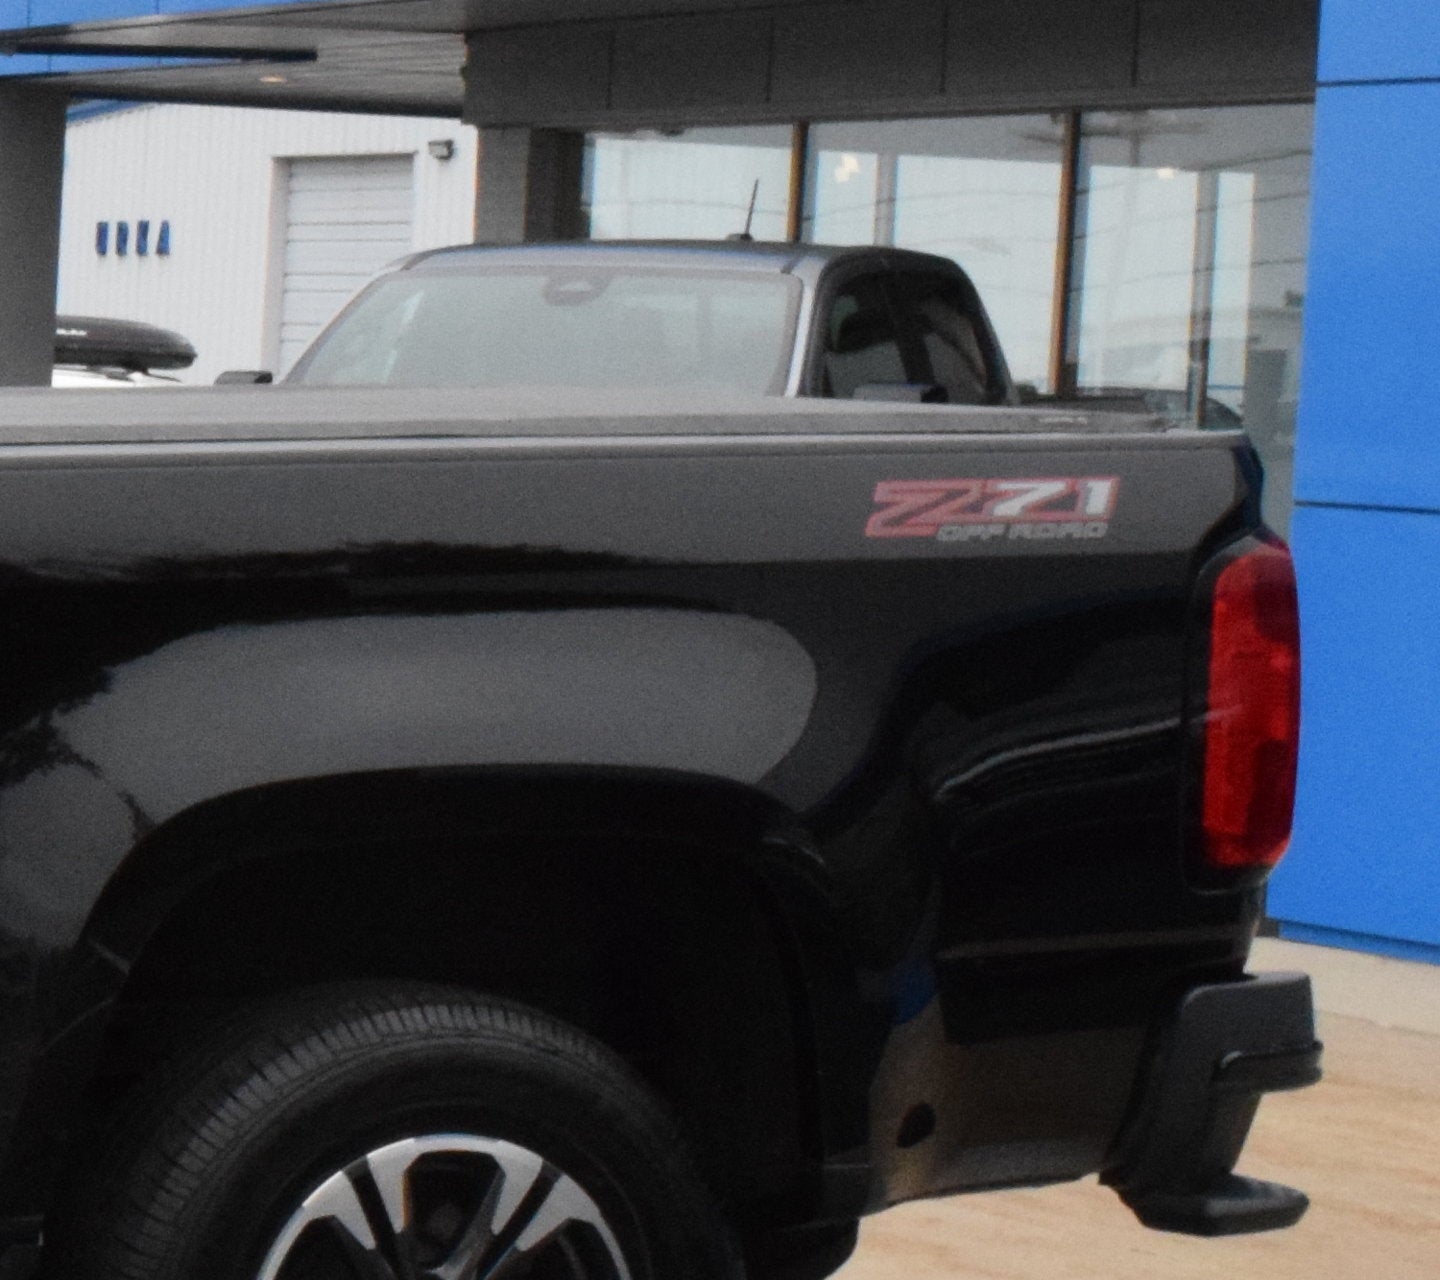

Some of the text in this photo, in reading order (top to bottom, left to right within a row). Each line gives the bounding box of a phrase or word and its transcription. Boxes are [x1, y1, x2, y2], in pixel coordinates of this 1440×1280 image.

[864, 475, 1120, 538] Z71
[936, 522, 1108, 541] OFF ROAD
